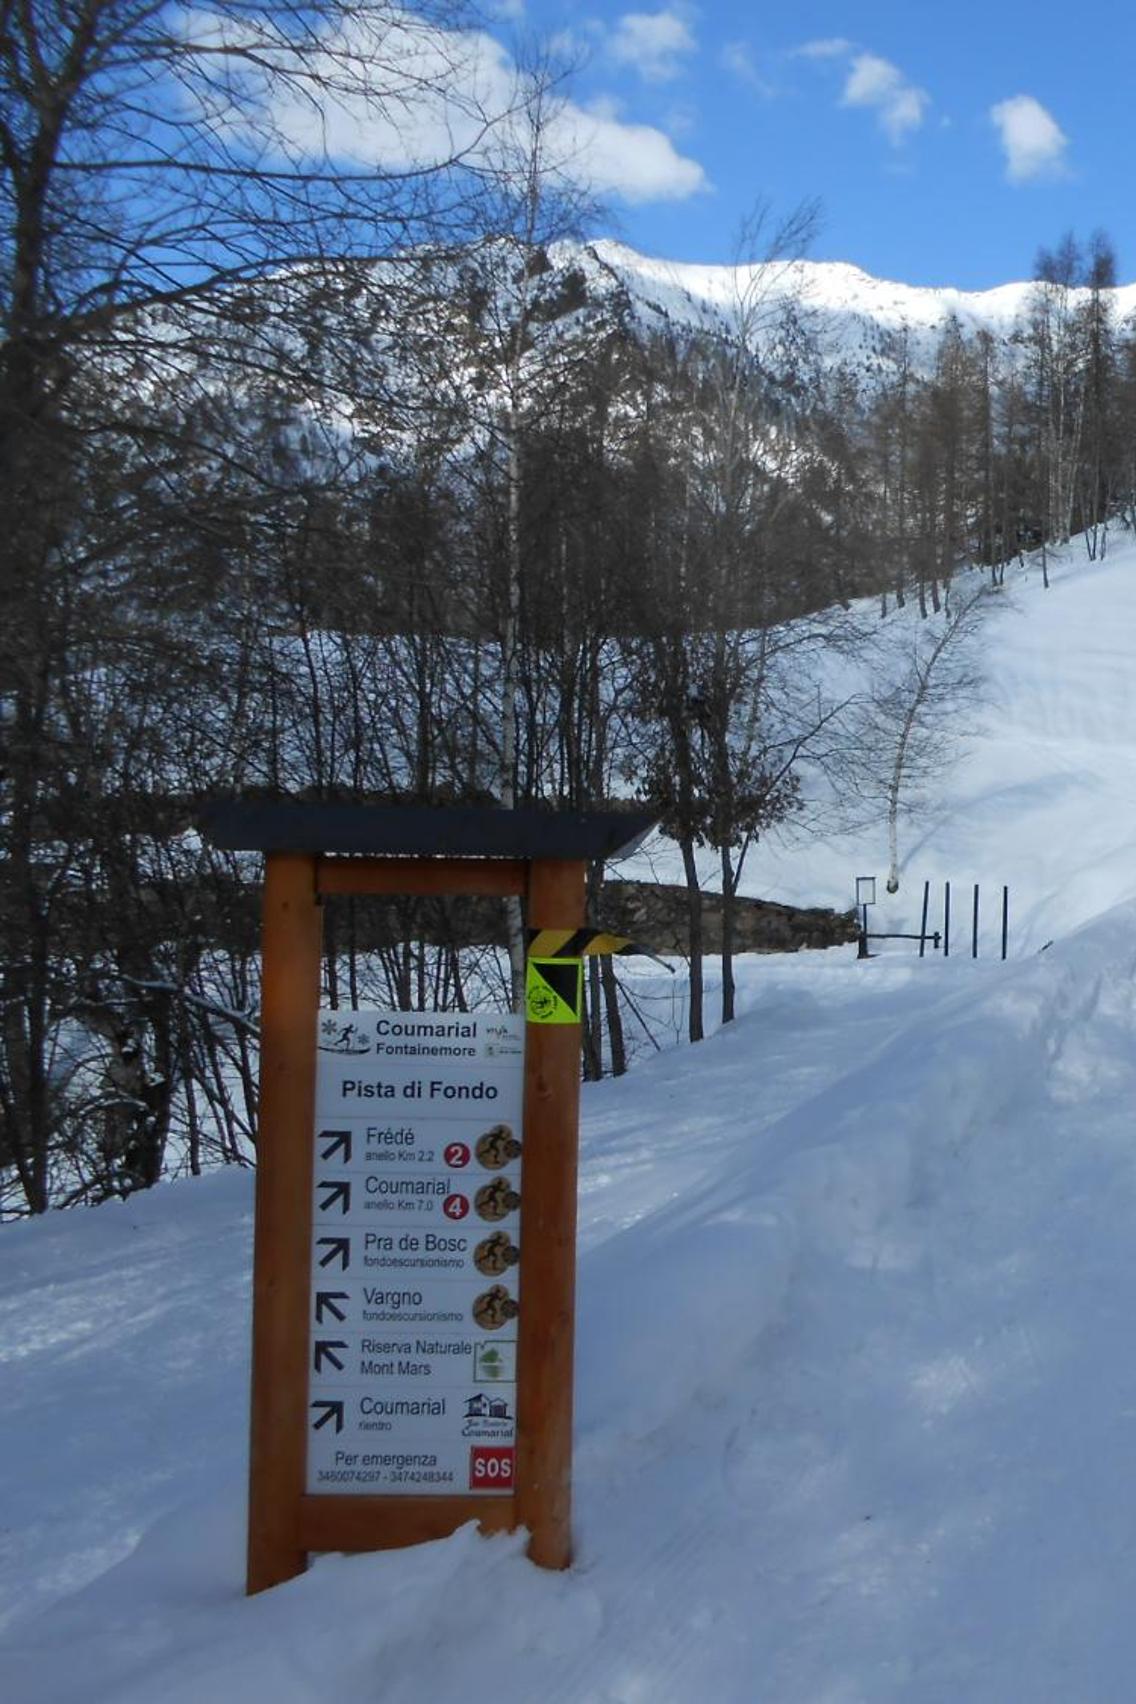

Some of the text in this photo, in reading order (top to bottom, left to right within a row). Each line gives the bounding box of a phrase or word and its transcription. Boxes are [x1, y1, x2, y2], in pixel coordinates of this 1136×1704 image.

[376, 1019, 477, 1038] Coumarial
[376, 1042, 476, 1057] Fontainemore
[341, 1080, 498, 1099] Pista di Fondo
[366, 1127, 415, 1146] Frédé
[365, 1150, 435, 1162] anello Km 2.2
[450, 1146, 464, 1165] 2
[365, 1175, 451, 1194] Coumarial
[364, 1199, 434, 1211] anello Km 7.0
[448, 1197, 462, 1217] 4
[364, 1233, 467, 1252] Pra de Bosc
[363, 1255, 465, 1268] fondoescursionismo
[363, 1288, 423, 1309] Vargno
[362, 1309, 464, 1321] fondoescursionismo
[361, 1339, 473, 1355] Riserva Naturale
[360, 1361, 431, 1376] Mont Mars
[360, 1396, 446, 1416] Coumarial
[359, 1420, 392, 1432] rientro
[335, 1451, 437, 1470] Per emergenza
[474, 1458, 512, 1478] SOS
